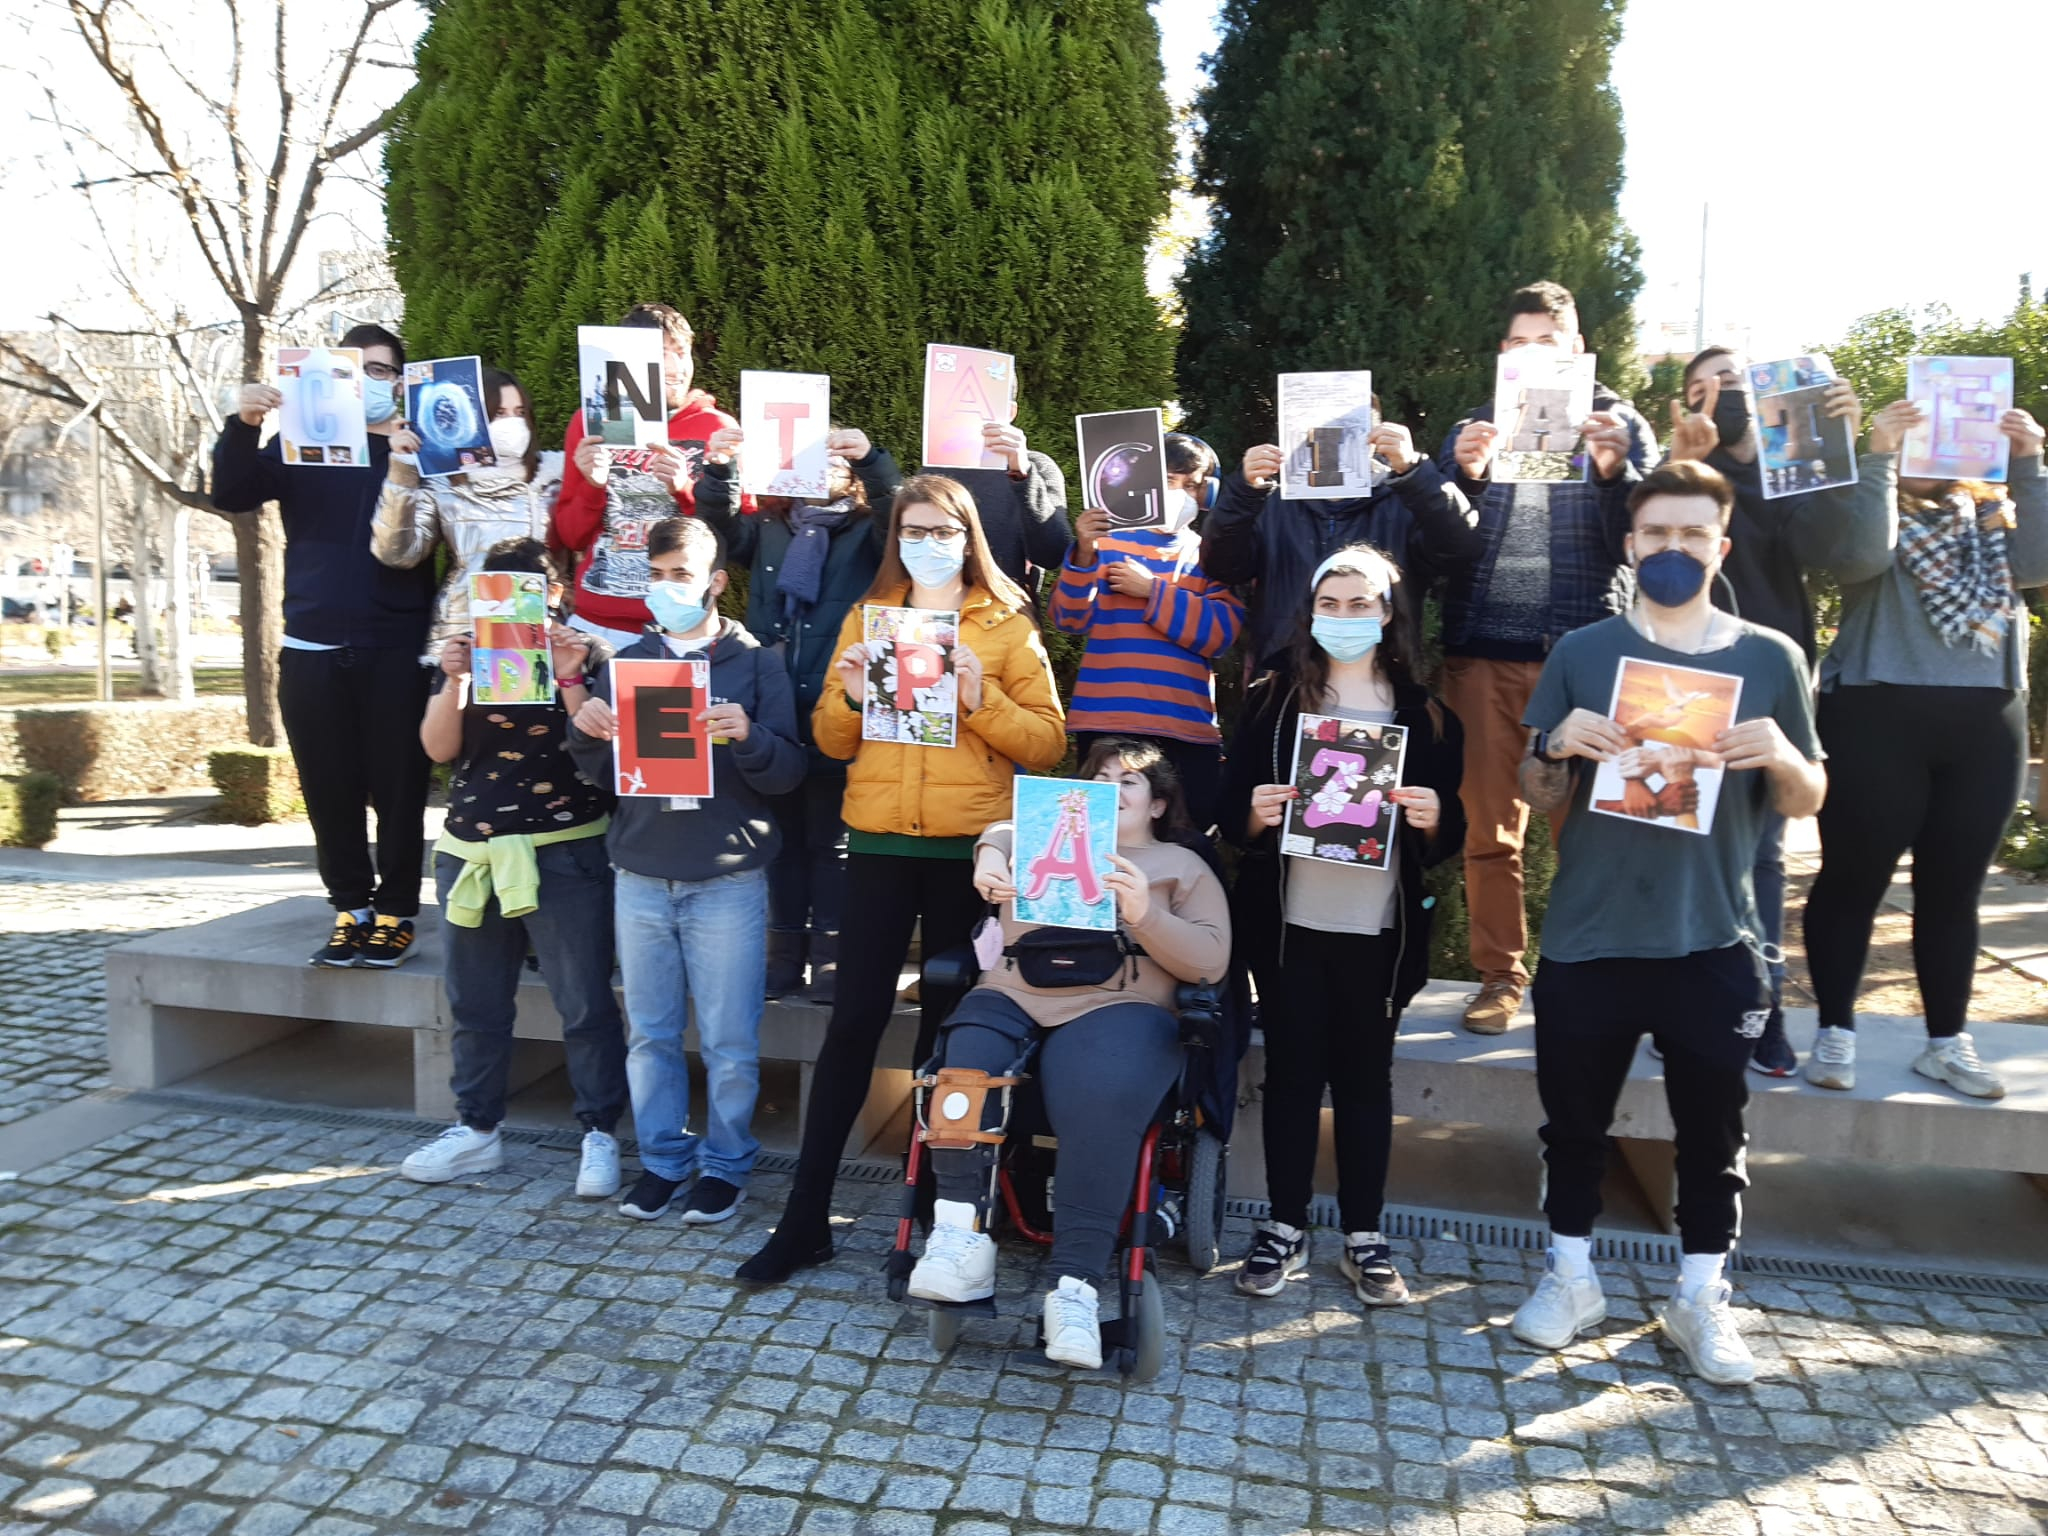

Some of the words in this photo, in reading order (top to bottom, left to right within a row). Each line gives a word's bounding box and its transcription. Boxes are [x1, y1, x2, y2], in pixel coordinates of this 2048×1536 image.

[303, 370, 339, 442] C
[417, 380, 478, 450] O
[605, 360, 662, 422] N
[943, 365, 996, 421] A
[1505, 387, 1580, 452] A
[1931, 374, 1997, 461] E
[764, 402, 810, 470] T
[1307, 427, 1345, 488] I
[1088, 441, 1160, 525] G
[894, 641, 944, 711] P
[634, 686, 697, 759] E
[1302, 747, 1384, 829] Z
[1024, 800, 1105, 906] A
